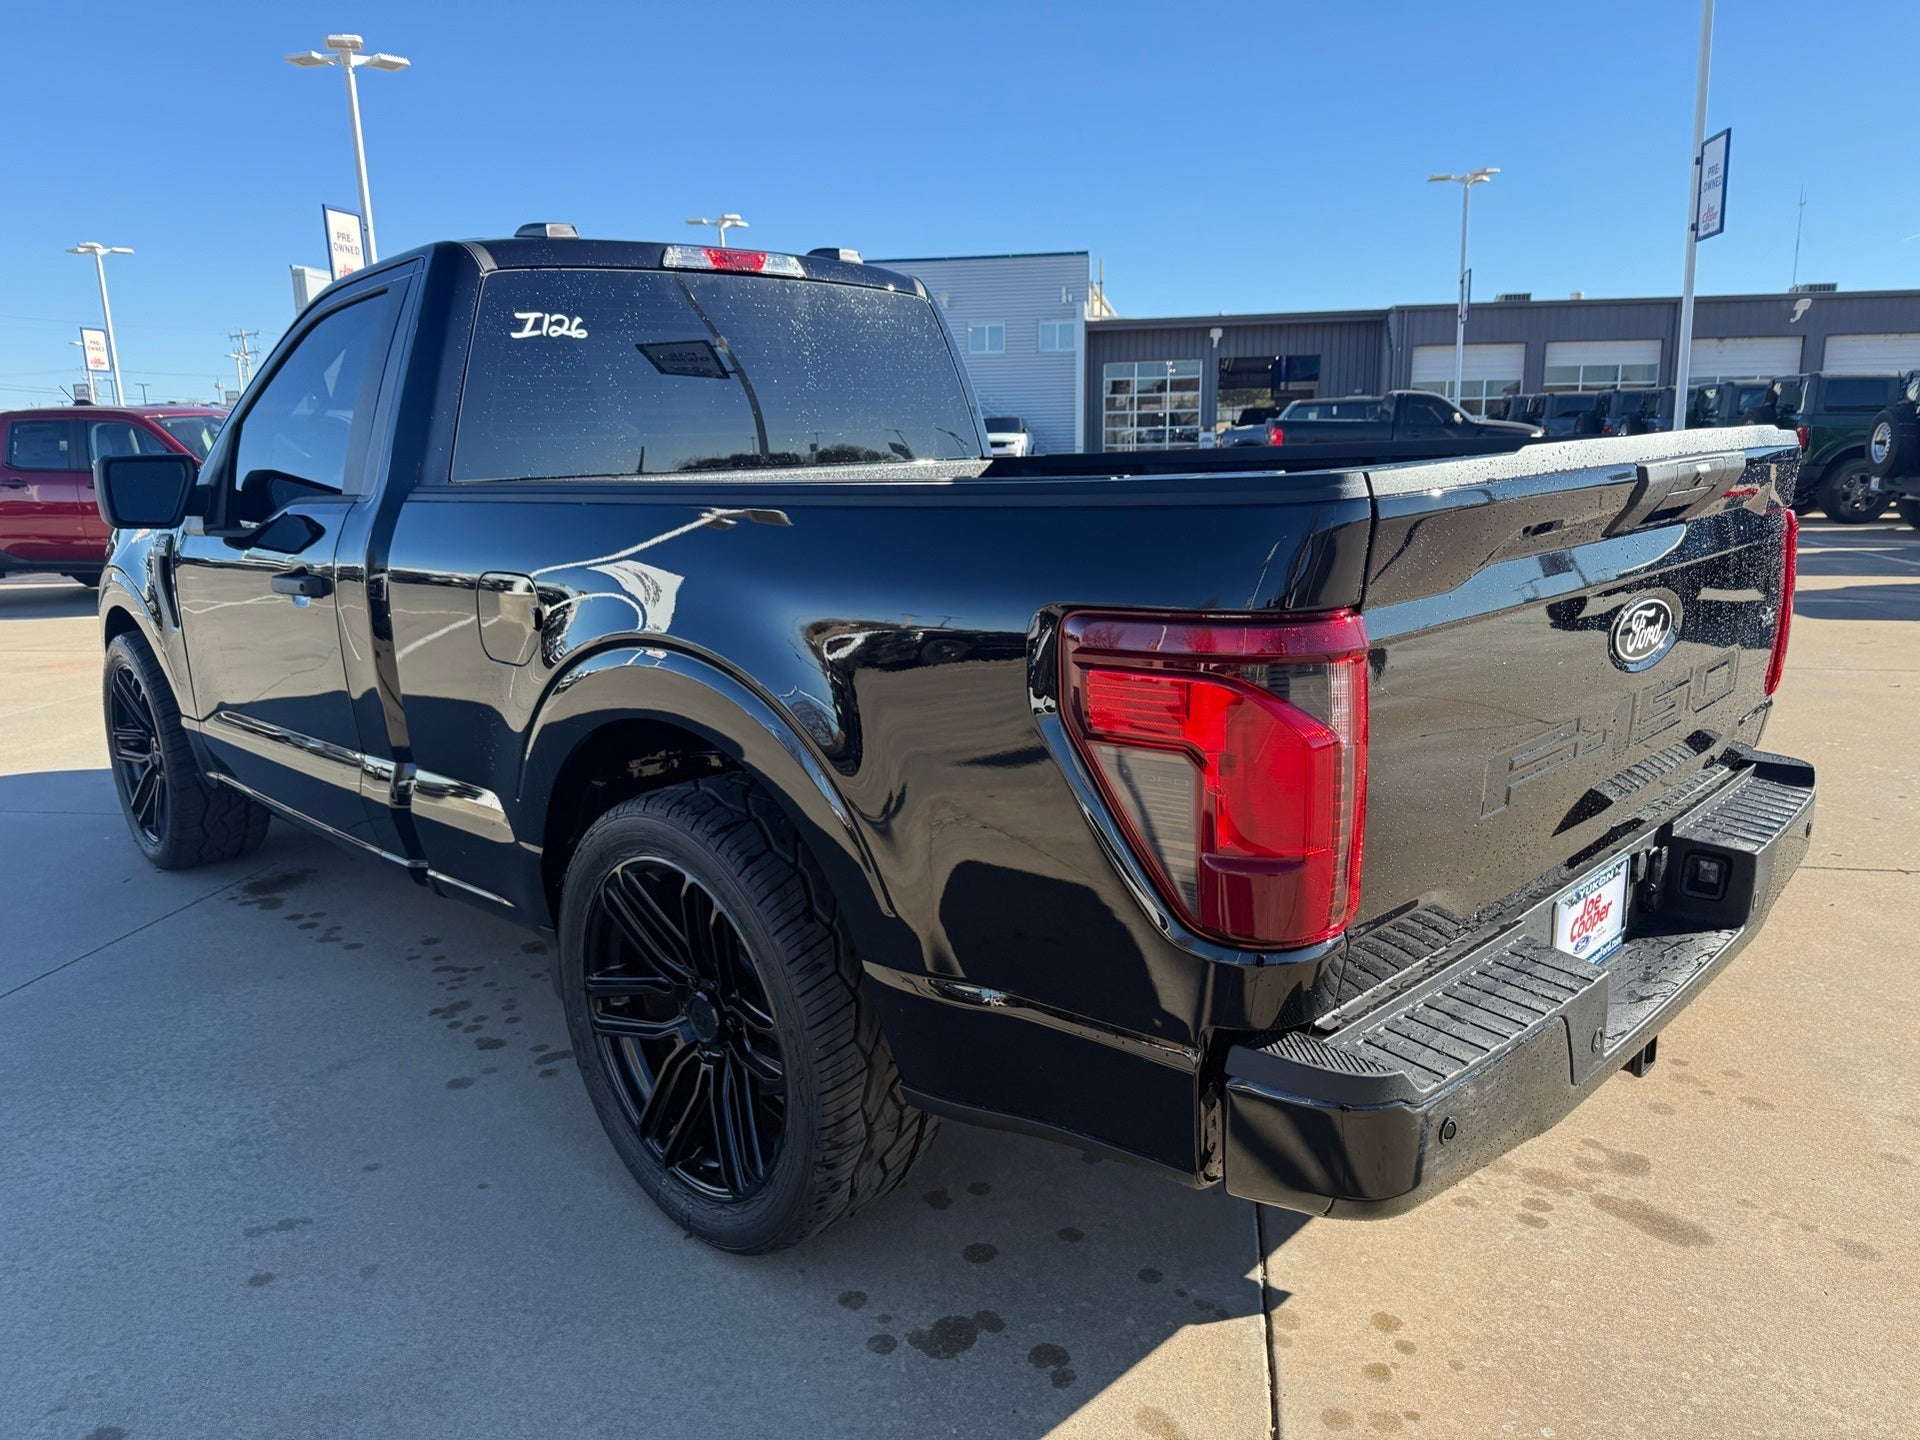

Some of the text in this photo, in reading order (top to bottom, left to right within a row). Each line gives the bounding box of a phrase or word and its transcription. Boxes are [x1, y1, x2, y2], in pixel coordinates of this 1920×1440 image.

[1707, 163, 1720, 178] PRE-
[333, 242, 360, 256] OWNED
[336, 231, 354, 243] PRE-
[1627, 608, 1664, 653] Ford
[1579, 868, 1617, 899] YUKON
[1580, 893, 1602, 921] Joe
[1570, 900, 1612, 943] Cooper
